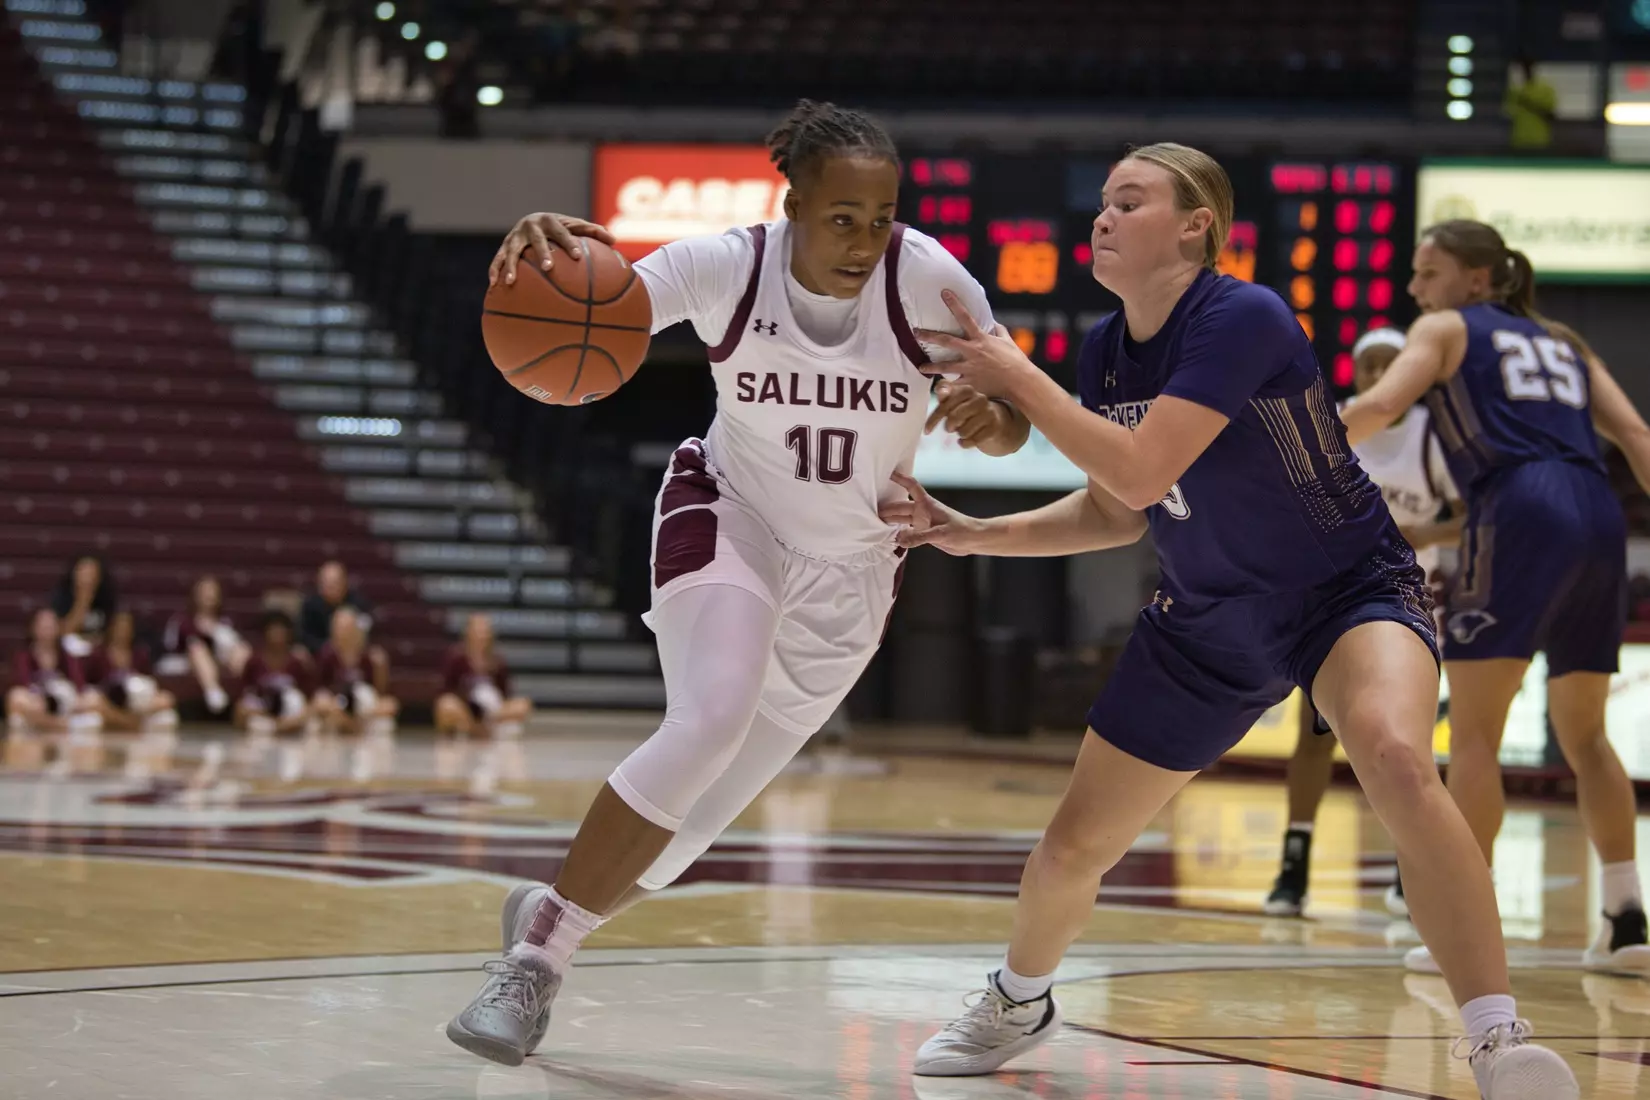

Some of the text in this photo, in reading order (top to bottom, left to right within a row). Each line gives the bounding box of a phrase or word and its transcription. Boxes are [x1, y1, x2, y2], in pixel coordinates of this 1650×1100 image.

[737, 372, 909, 413] SALUKIS
[1491, 329, 1588, 410] 25
[785, 424, 858, 485] 10
